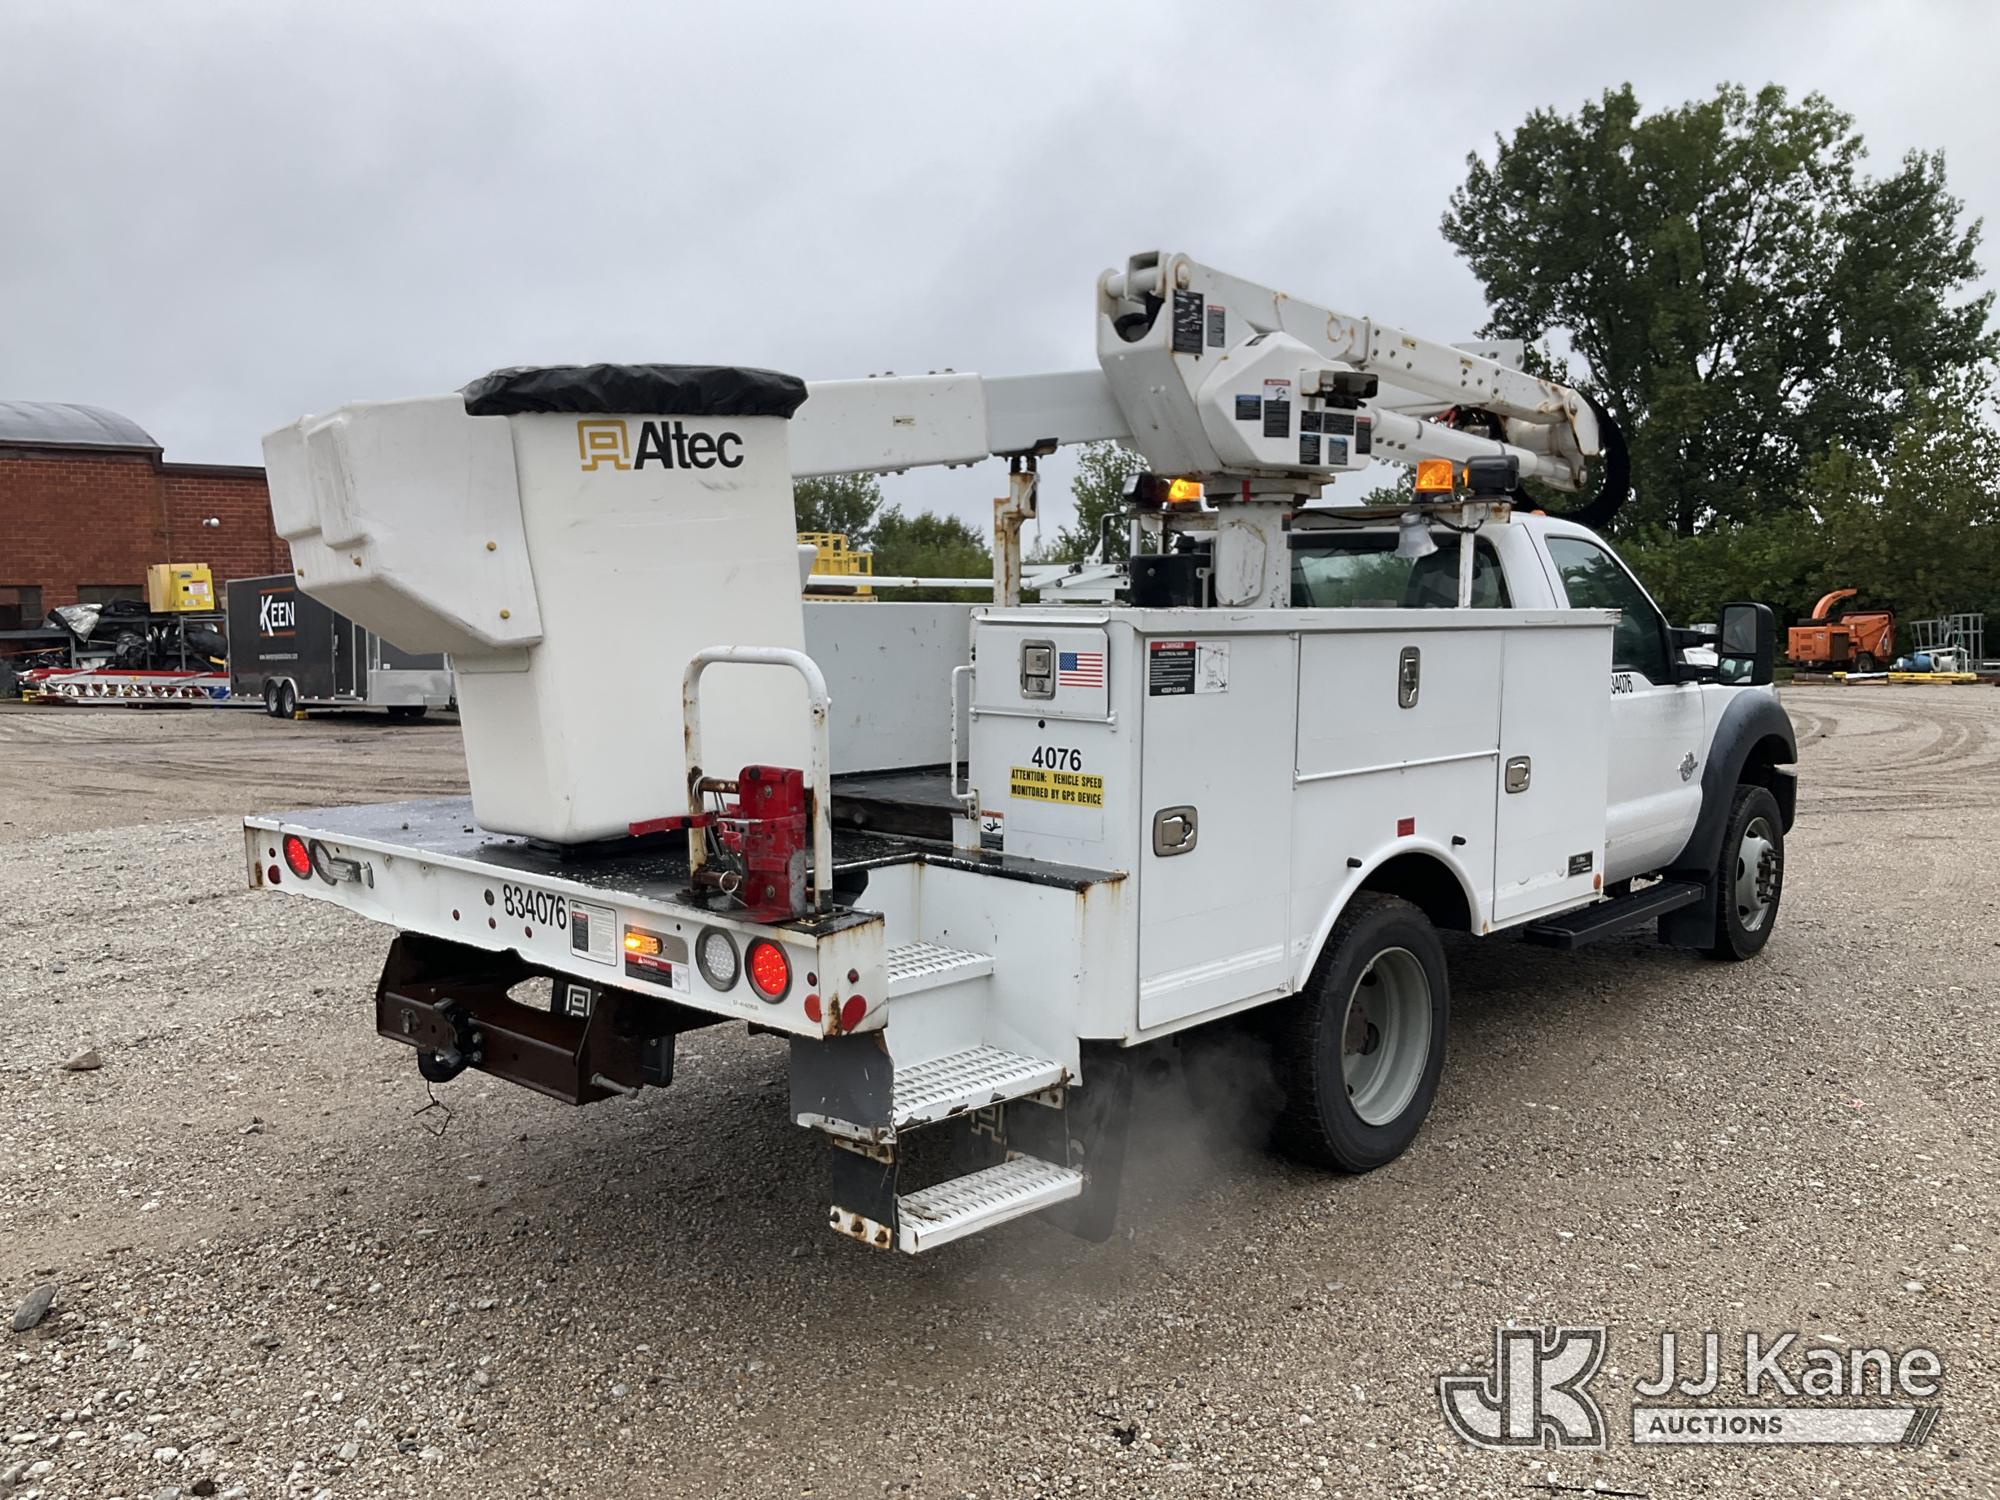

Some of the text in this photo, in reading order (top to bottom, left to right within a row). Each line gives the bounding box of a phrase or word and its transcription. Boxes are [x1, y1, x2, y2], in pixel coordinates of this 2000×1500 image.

[634, 421, 744, 470] Altec
[259, 595, 295, 637] KEEN
[1031, 746, 1082, 772] 4076
[1011, 769, 1102, 789] ATTENTION: VEHICLE SPEED
[1011, 784, 1101, 805] MONITORED BY GPS DEVICE
[503, 884, 567, 930] 834076
